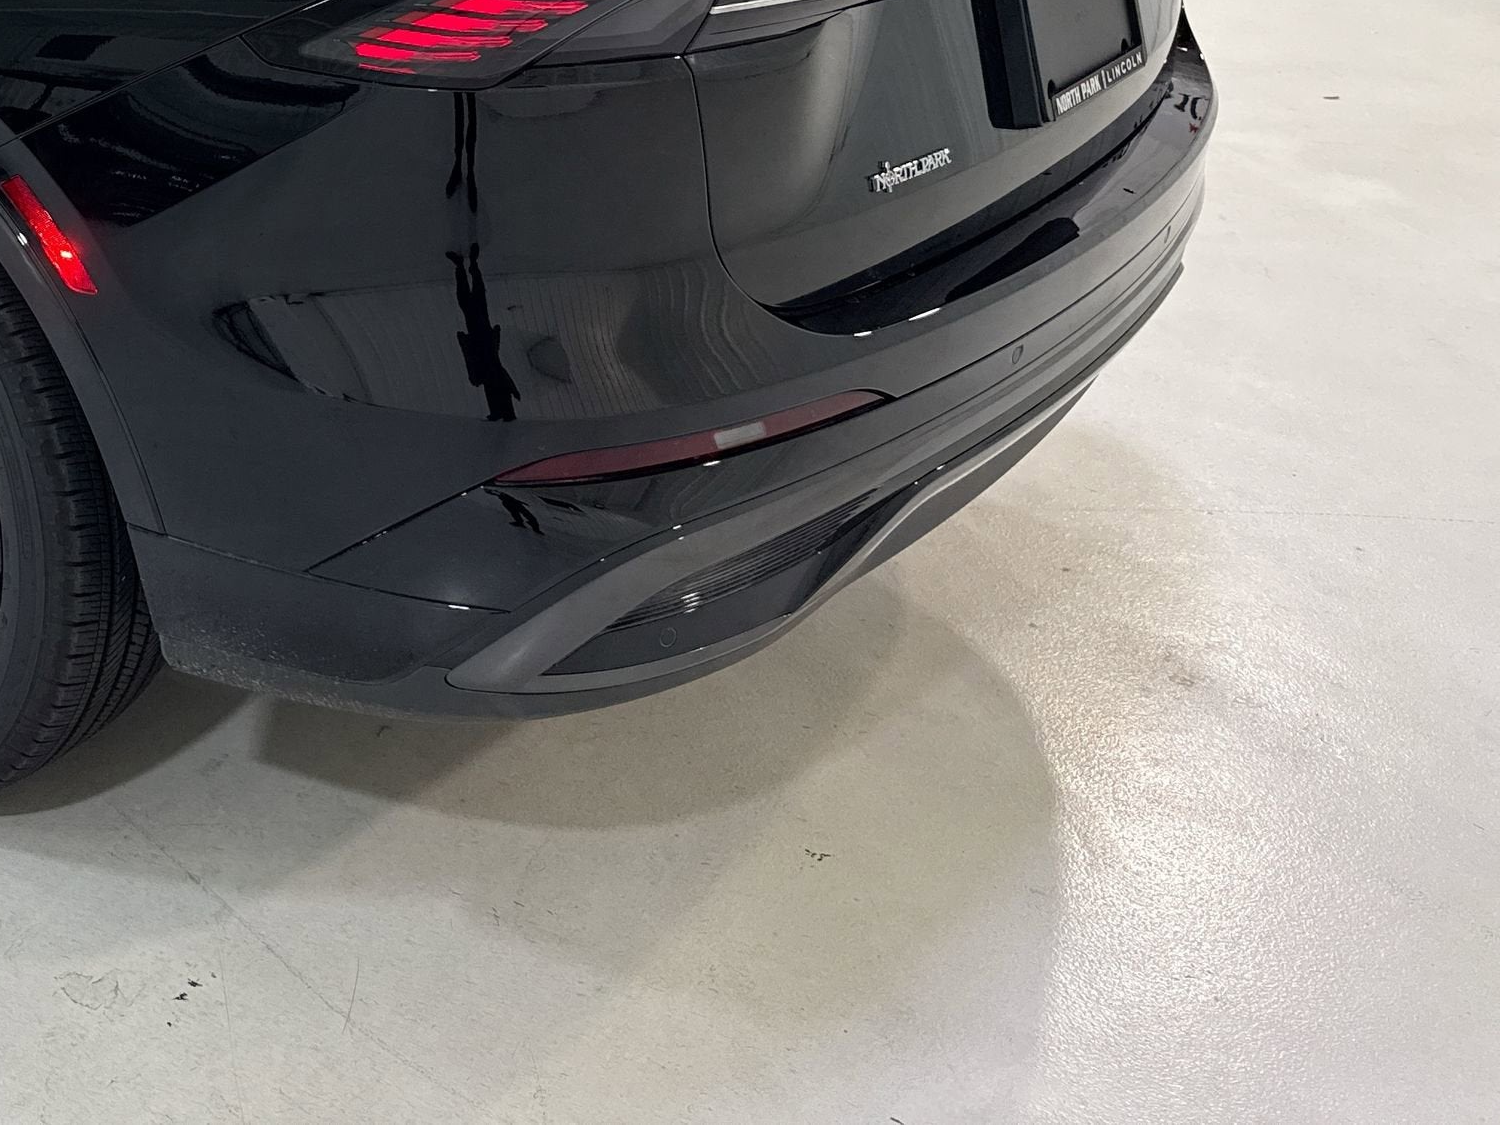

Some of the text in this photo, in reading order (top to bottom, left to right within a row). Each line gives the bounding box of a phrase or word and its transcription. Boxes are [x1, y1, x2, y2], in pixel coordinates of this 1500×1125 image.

[1056, 51, 1143, 115] NORTH PARK LINCOLN
